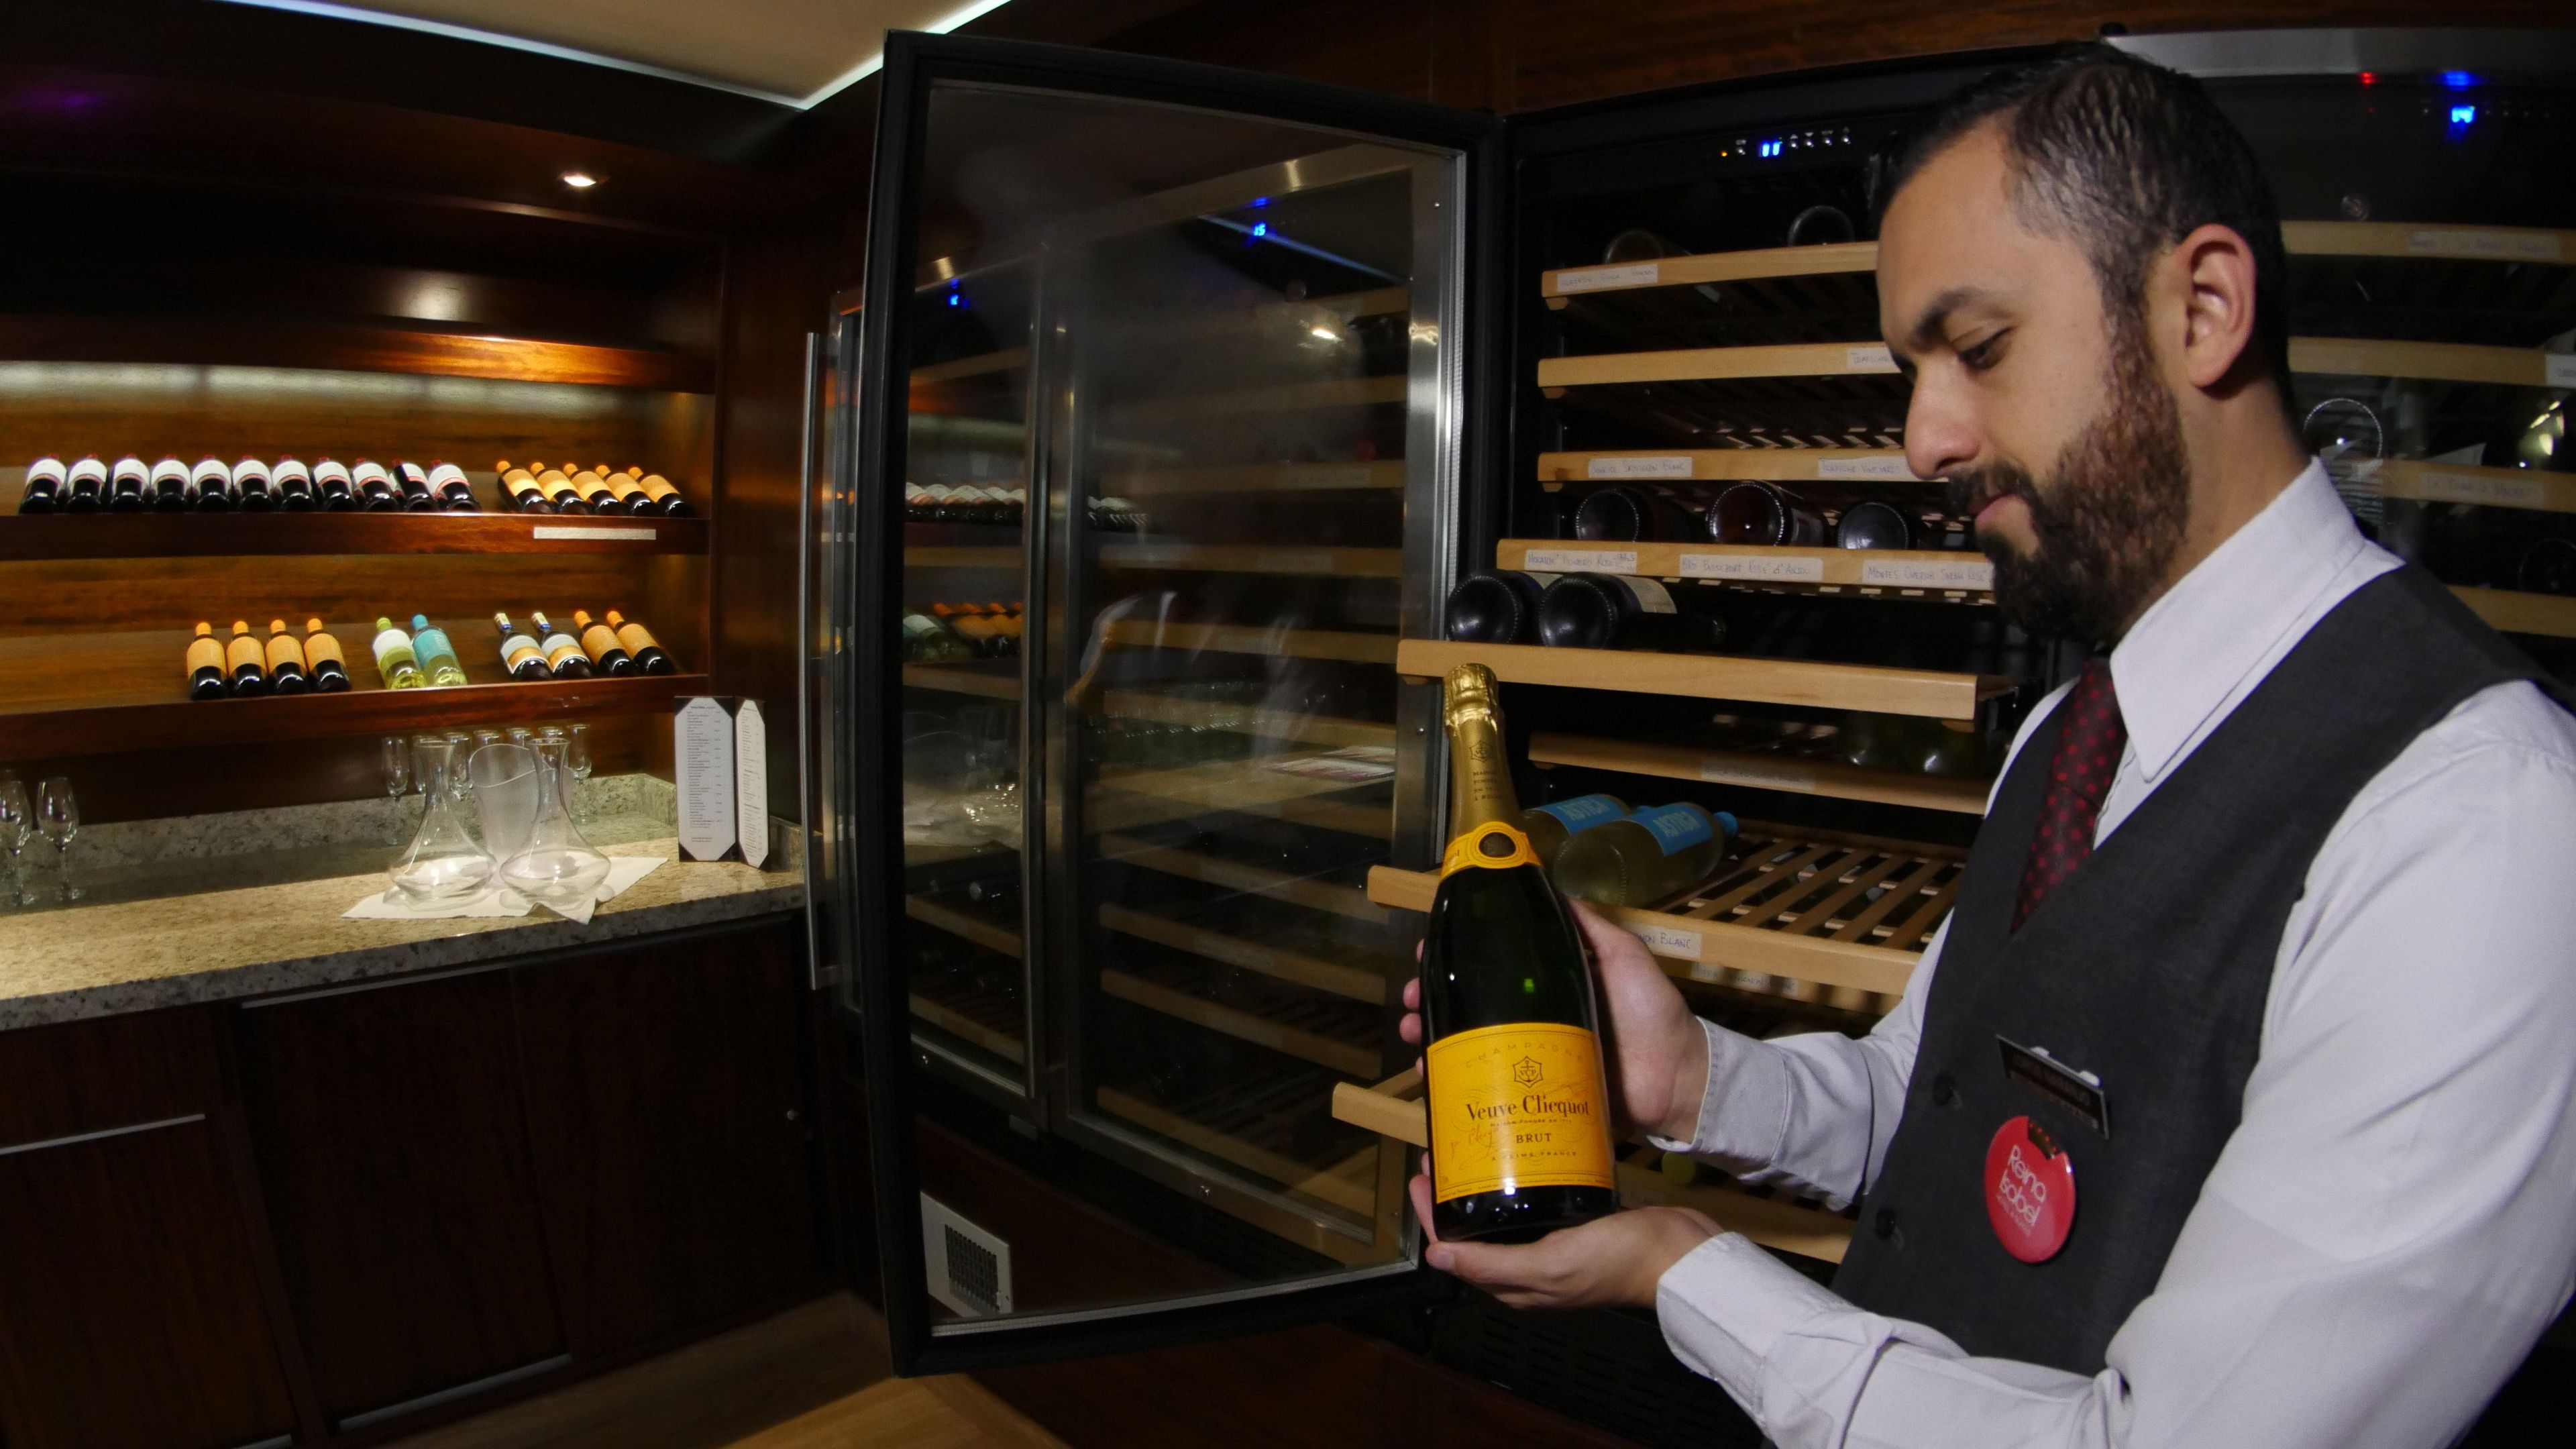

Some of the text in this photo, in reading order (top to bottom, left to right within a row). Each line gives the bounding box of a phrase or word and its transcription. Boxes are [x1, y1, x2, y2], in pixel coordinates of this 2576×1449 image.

[1660, 932, 1691, 949] BLANC
[1465, 1093, 1590, 1121] Veuve Clicquot
[1515, 1132, 1552, 1144] BRUT
